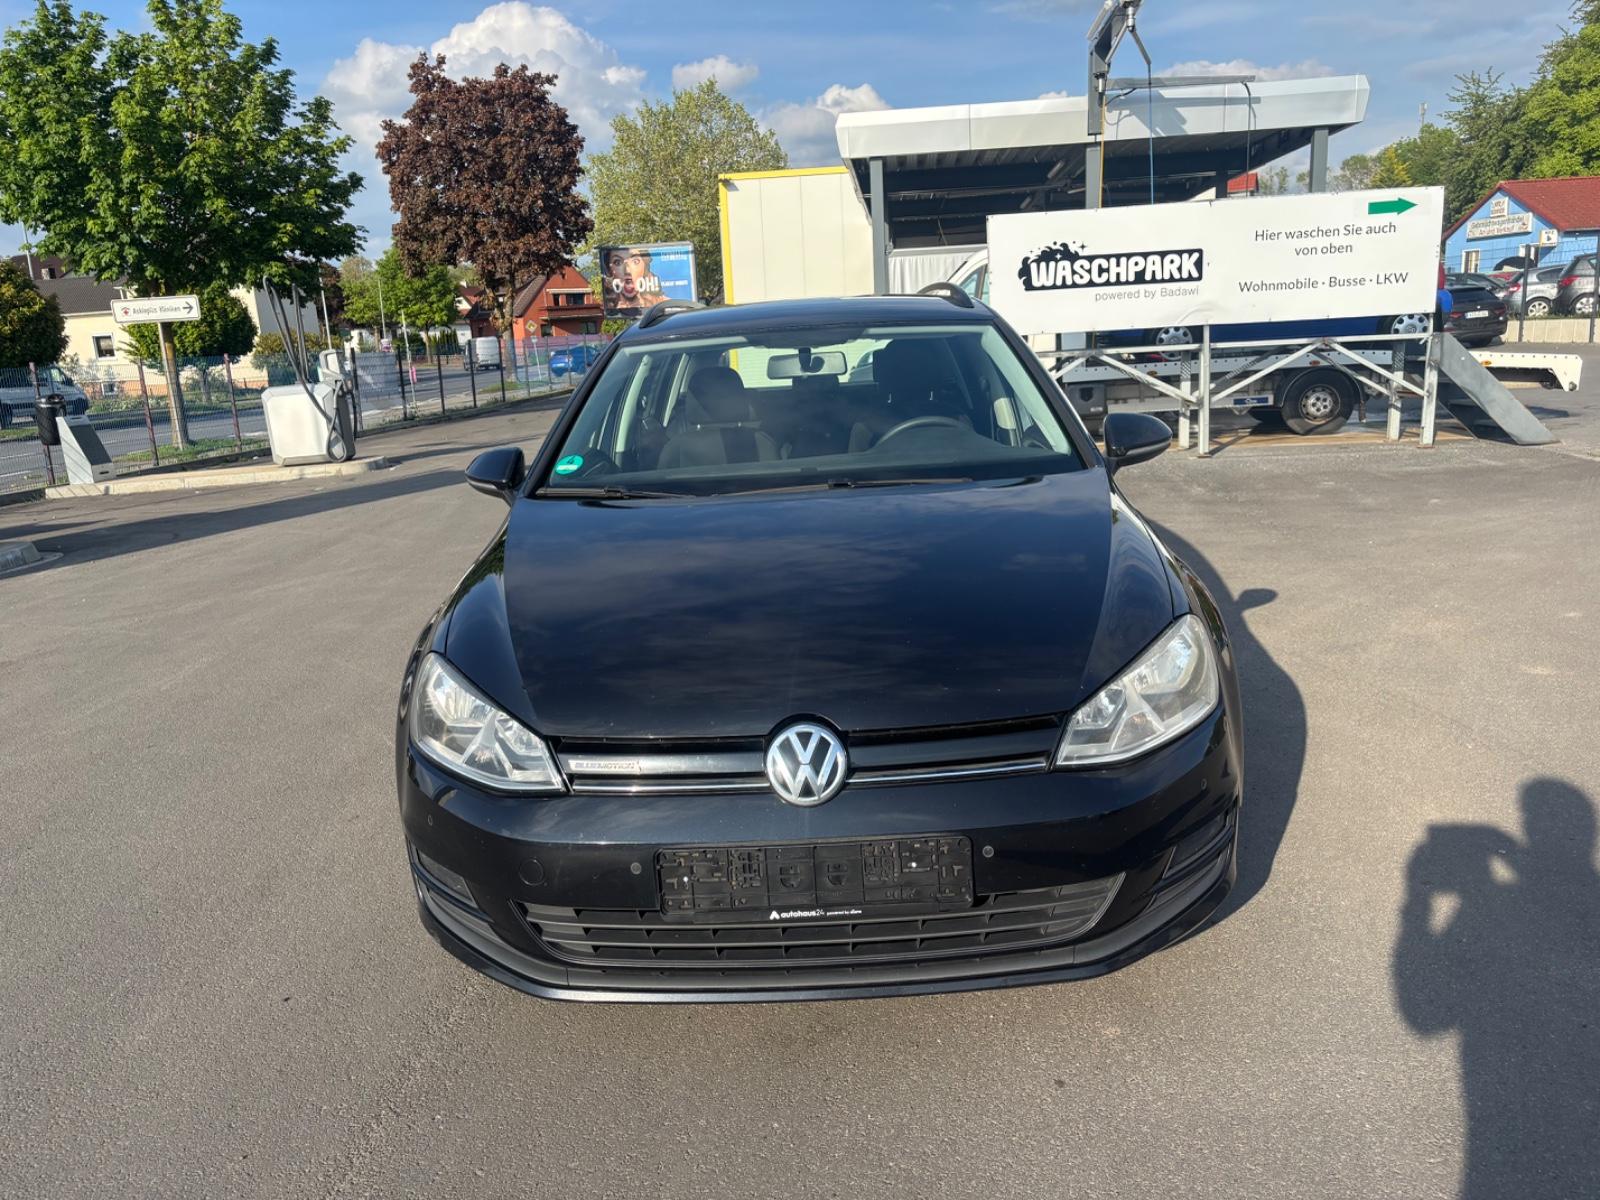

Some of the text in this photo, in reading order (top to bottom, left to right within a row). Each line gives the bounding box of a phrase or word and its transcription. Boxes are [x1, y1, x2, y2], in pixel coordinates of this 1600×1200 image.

[1254, 222, 1397, 241] Hier waschen Sie auch
[1294, 243, 1353, 256] von oben
[1029, 251, 1200, 288] WASCHPARK
[1238, 272, 1409, 292] Wohnmobile Busse LKW
[1094, 285, 1200, 302] powered by Badawi
[770, 727, 843, 803] VW
[780, 908, 825, 919] autohaus24
